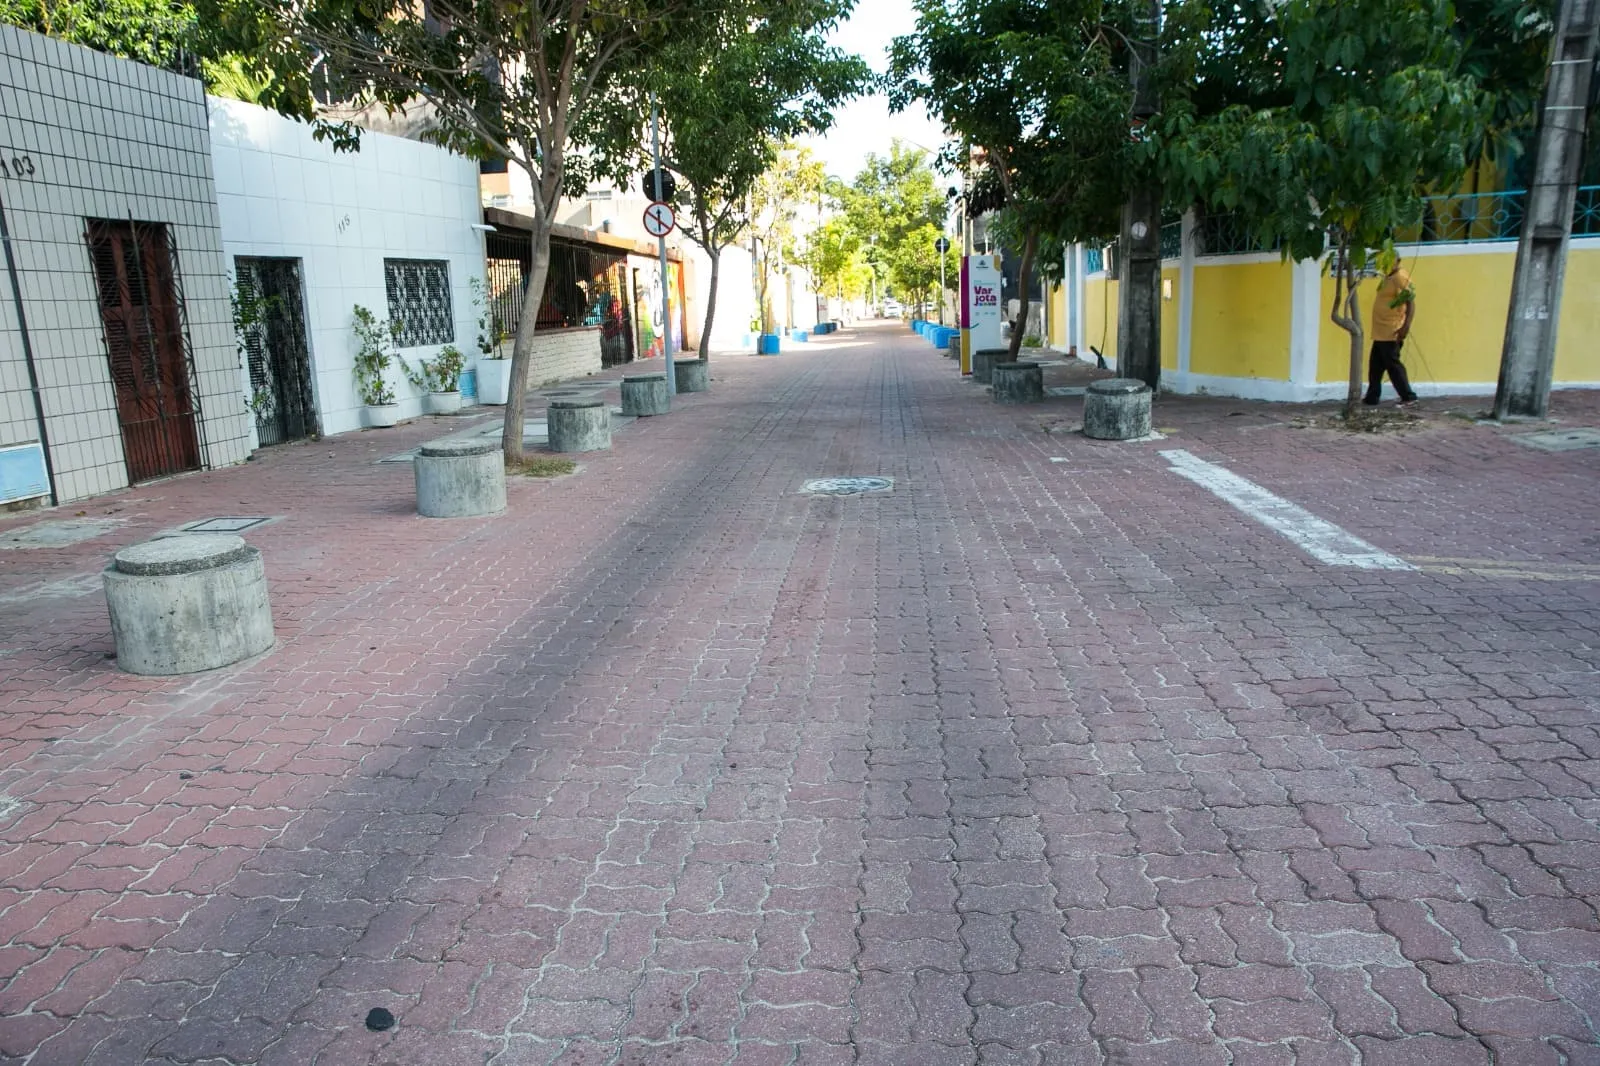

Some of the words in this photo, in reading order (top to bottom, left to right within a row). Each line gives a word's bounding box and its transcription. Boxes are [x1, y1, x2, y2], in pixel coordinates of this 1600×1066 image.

[1, 155, 35, 178] 103
[338, 213, 350, 234] 115
[974, 285, 993, 295] Var
[973, 294, 997, 306] jota
